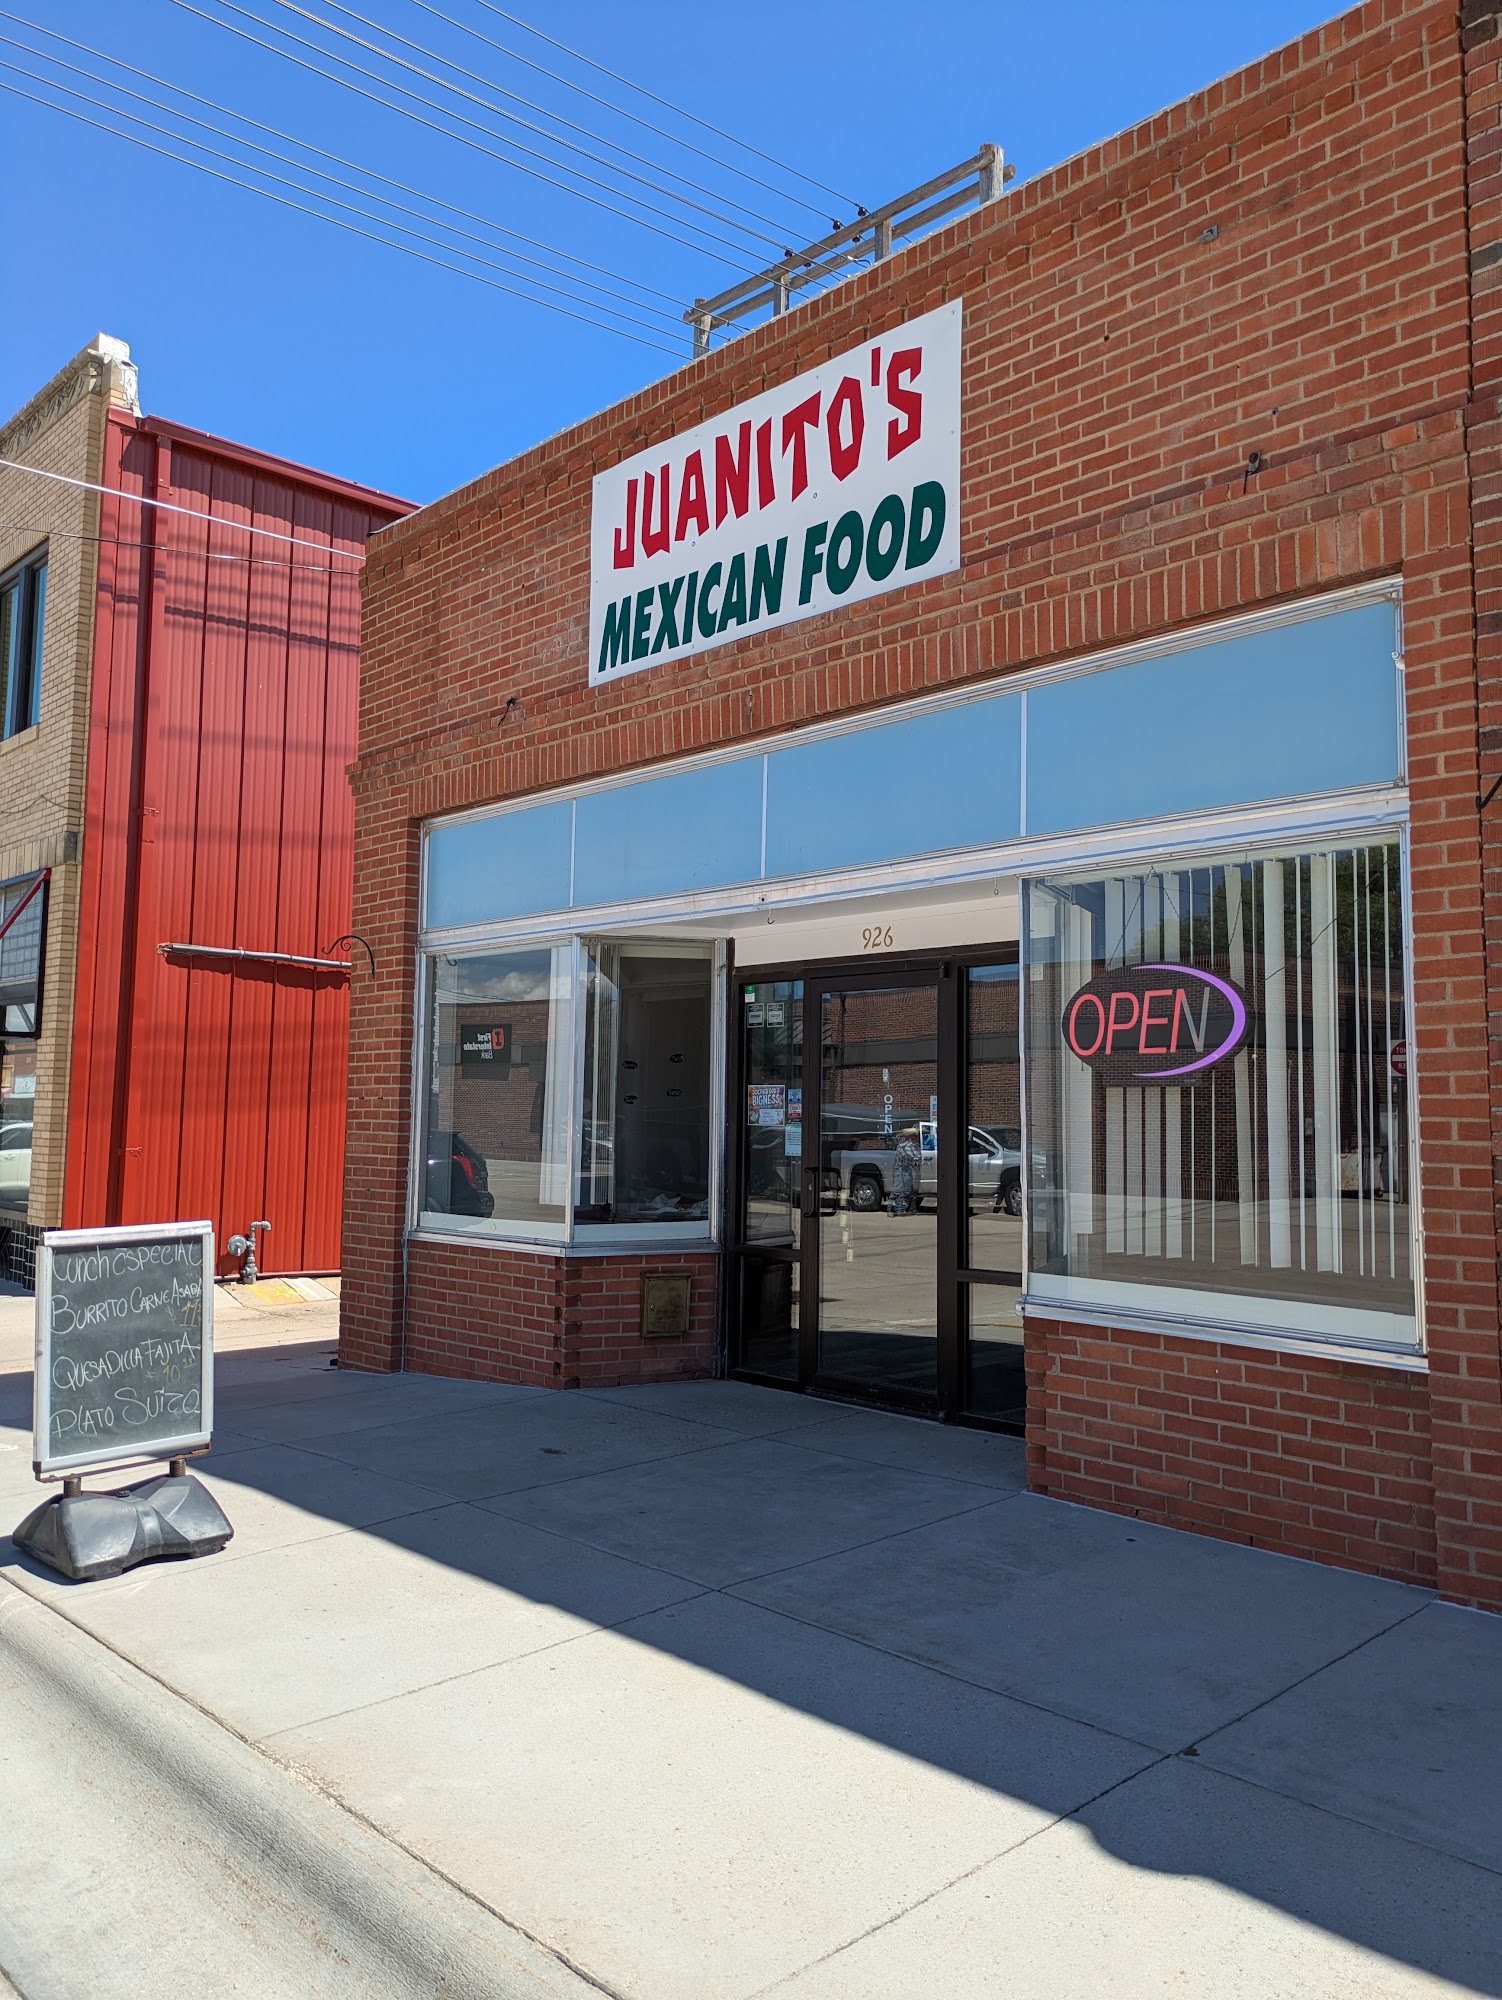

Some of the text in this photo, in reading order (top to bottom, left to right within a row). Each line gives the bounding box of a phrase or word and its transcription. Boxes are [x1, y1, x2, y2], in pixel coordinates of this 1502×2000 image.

[613, 346, 923, 570] JUANITO'S
[597, 480, 946, 673] MEXICAN FOOD
[862, 925, 893, 949] 926
[1069, 986, 1211, 1056] OPEN
[752, 1094, 780, 1106] BIGNESS
[884, 1094, 893, 1134] OPEN
[130, 1286, 171, 1313] CARNE
[141, 1331, 201, 1367] FAJITA
